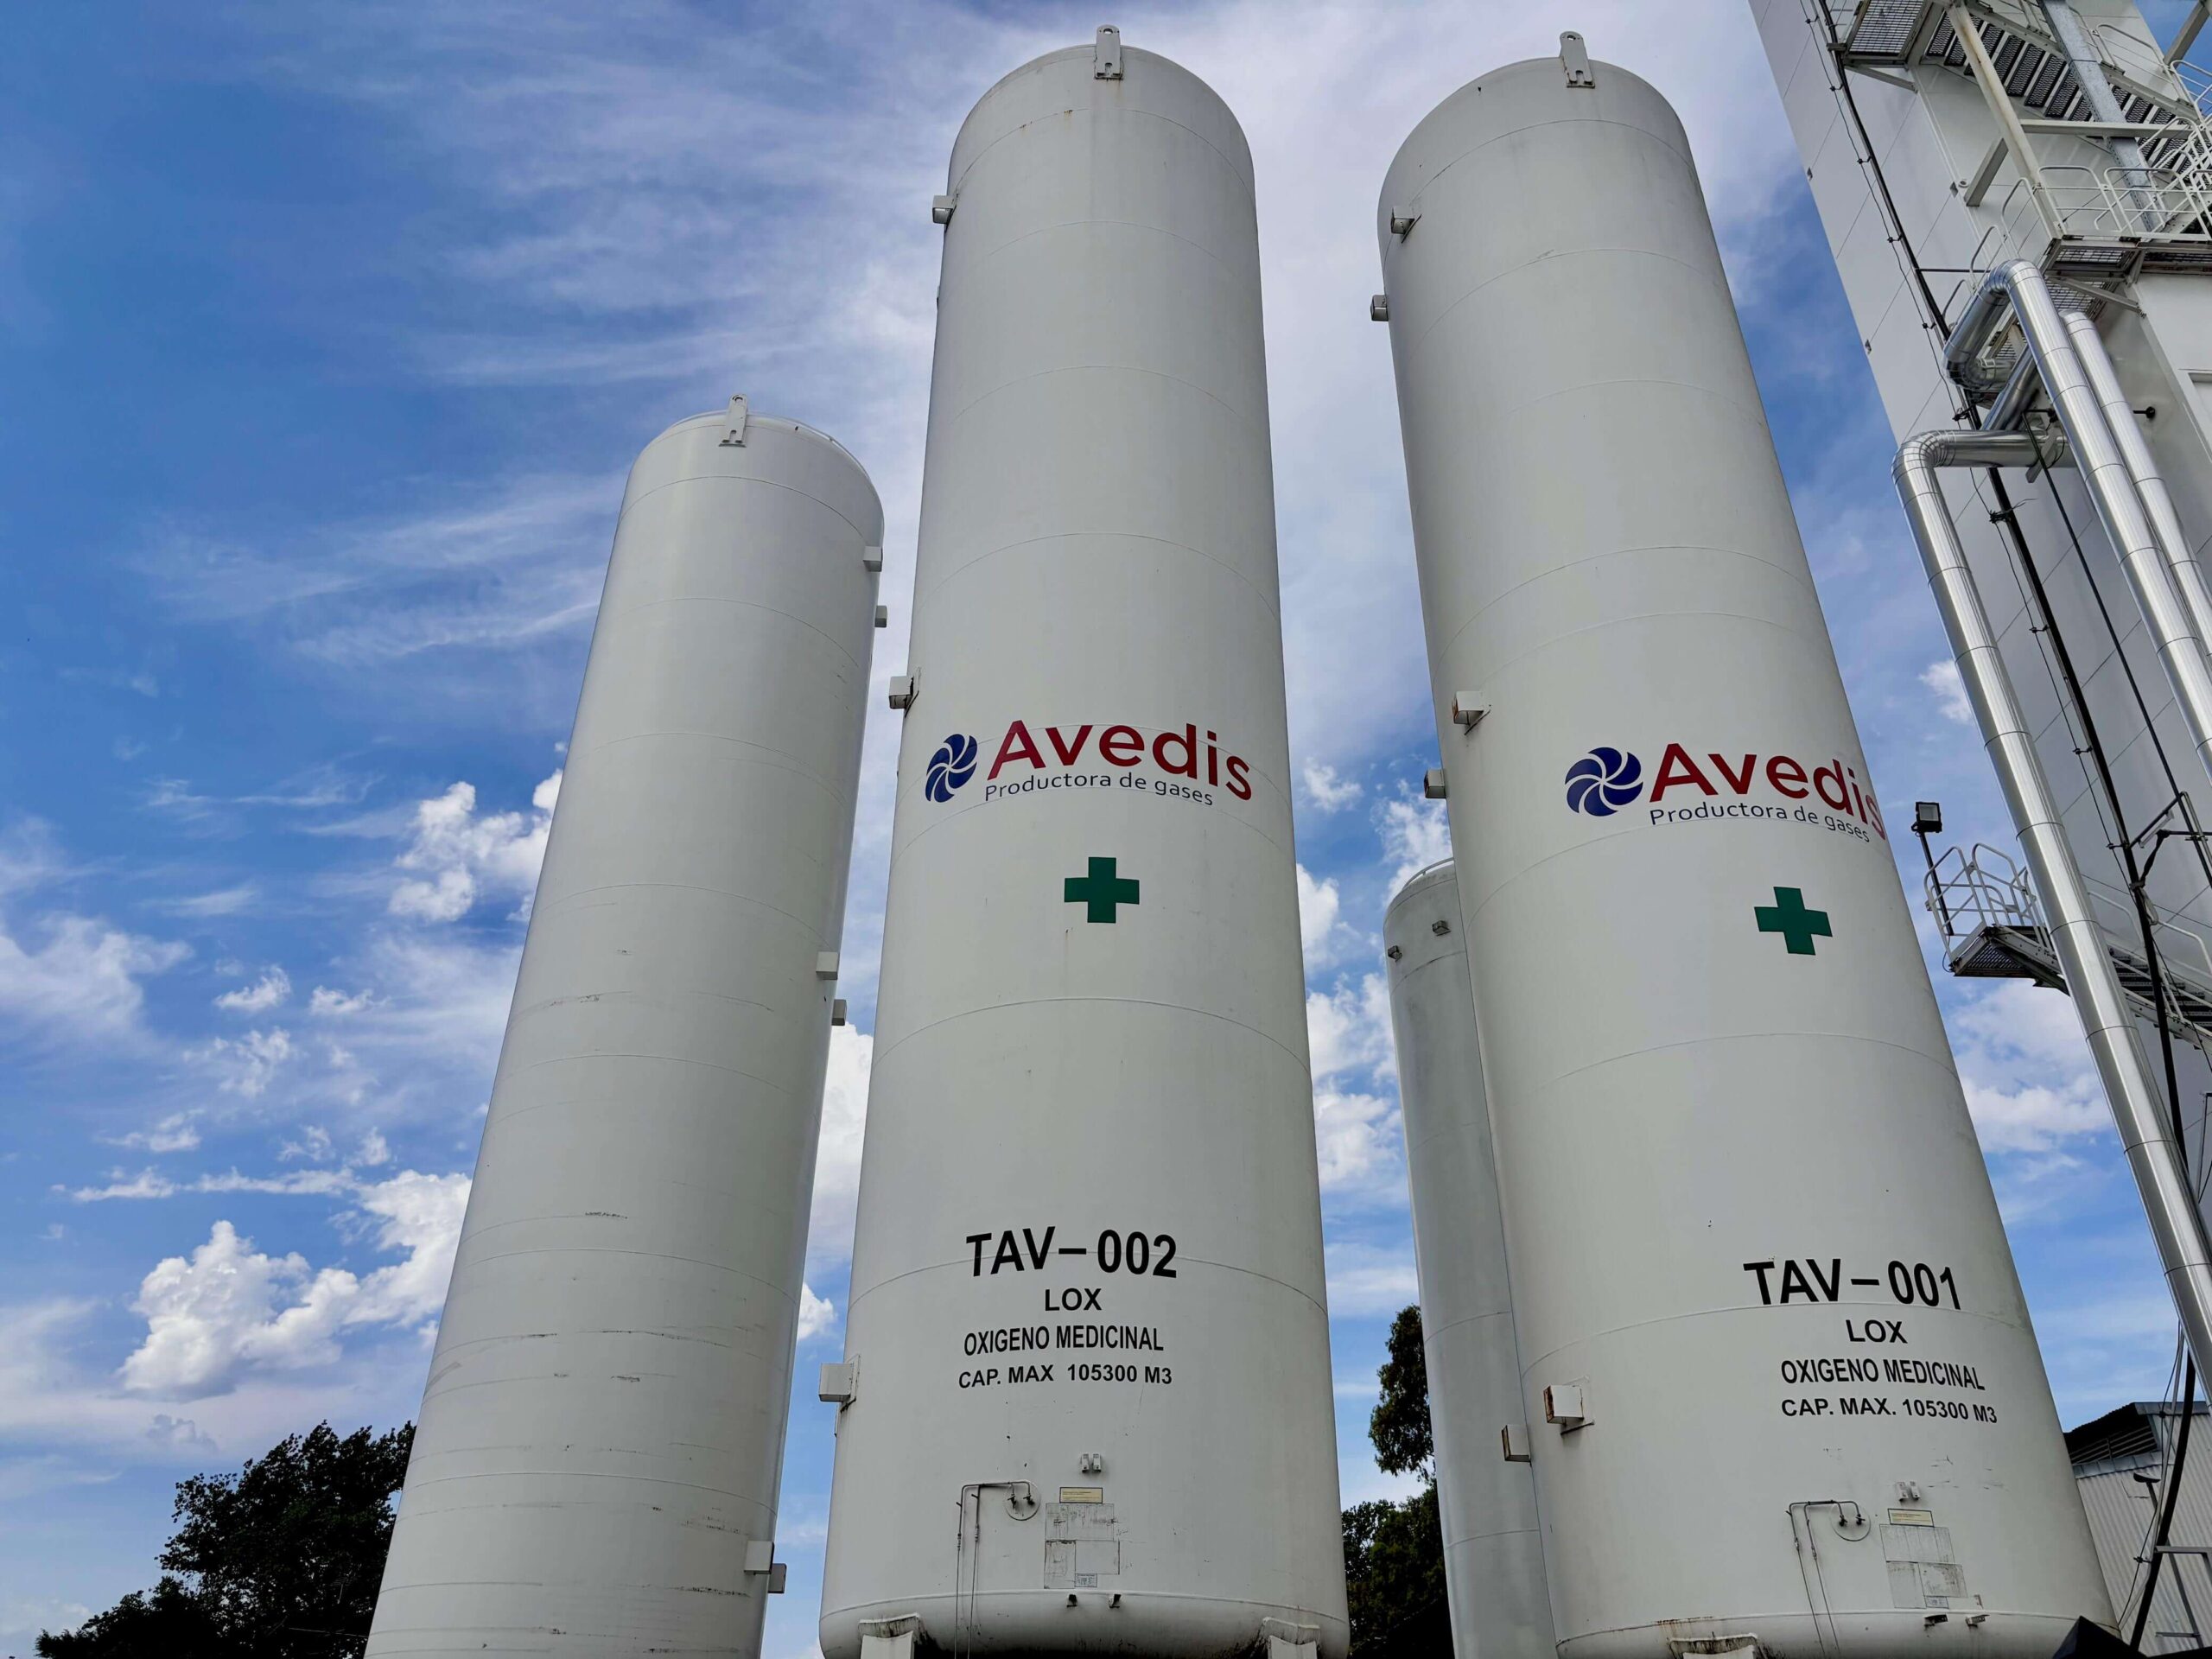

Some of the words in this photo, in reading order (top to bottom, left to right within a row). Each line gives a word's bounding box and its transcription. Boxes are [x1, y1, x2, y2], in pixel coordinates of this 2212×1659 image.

[987, 719, 1252, 800] Avedis
[985, 773, 1111, 801] Productora
[1119, 772, 1147, 790] de
[1154, 780, 1213, 805] gases
[1649, 742, 1885, 841] Avedis
[1649, 801, 1788, 825] Productora
[1794, 805, 1819, 824] de
[1824, 815, 1870, 842] gases
[1045, 1287, 1103, 1311] LOX
[963, 1325, 1050, 1356] OXIGENO
[1056, 1325, 1164, 1351] MEDICINAL
[1846, 1319, 1908, 1344] LOX
[958, 1367, 1001, 1389] CAP.
[1007, 1364, 1054, 1384] MAX
[1067, 1363, 1138, 1382] 105300
[1144, 1366, 1173, 1385] M3
[1781, 1358, 1879, 1384] OXIGENO
[1884, 1359, 1986, 1390] MEDICINAL
[1781, 1398, 1834, 1417] CAP.
[1840, 1397, 1897, 1416] MAX.
[1903, 1399, 1969, 1421] 105300
[1973, 1404, 1998, 1423] M3
